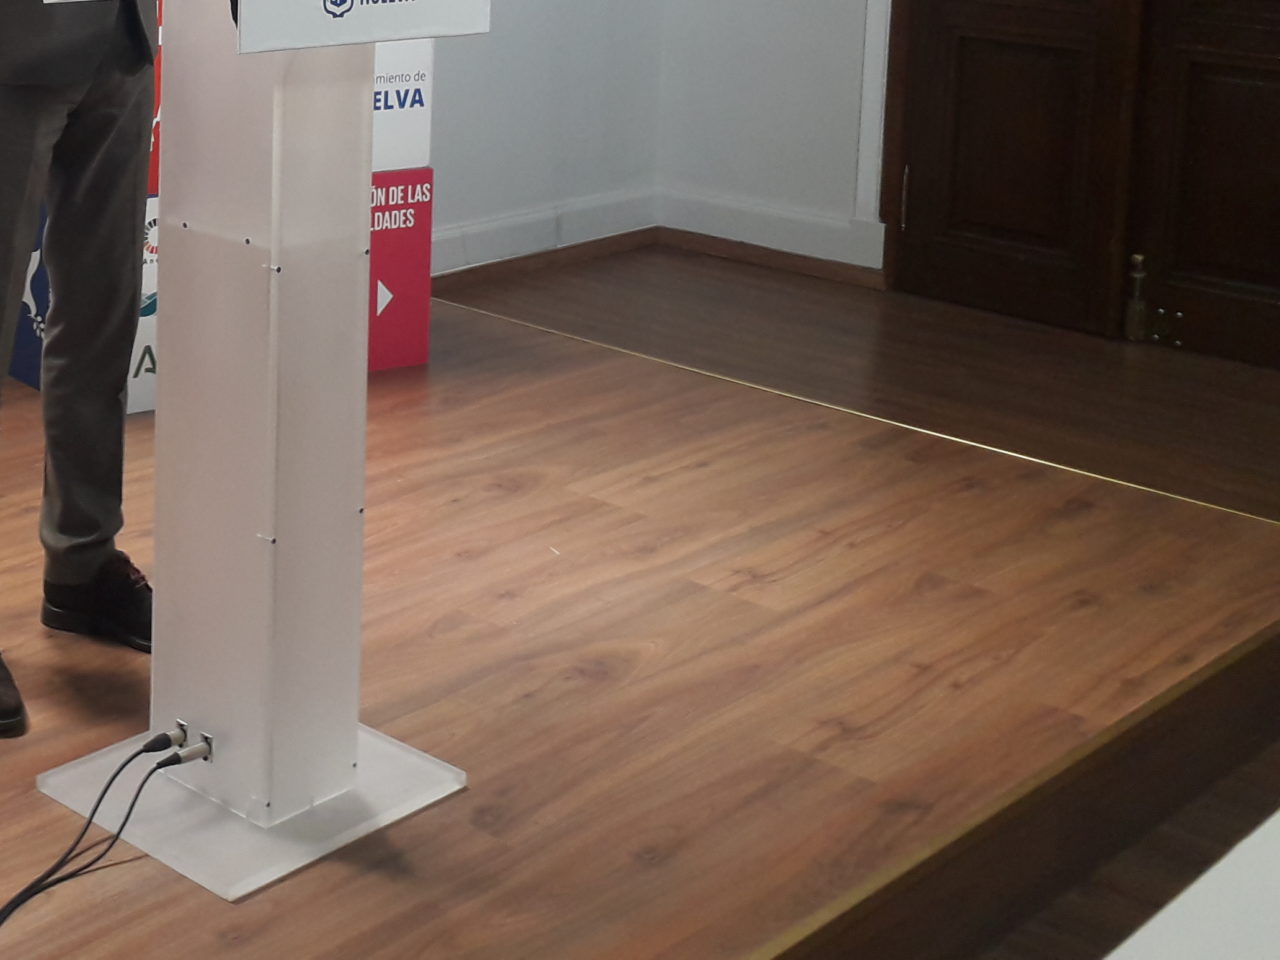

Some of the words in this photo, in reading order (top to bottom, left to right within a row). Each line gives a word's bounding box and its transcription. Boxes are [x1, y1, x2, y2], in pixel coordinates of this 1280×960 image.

[413, 70, 426, 82] de
[389, 186, 405, 205] DE
[408, 183, 431, 203] LAS
